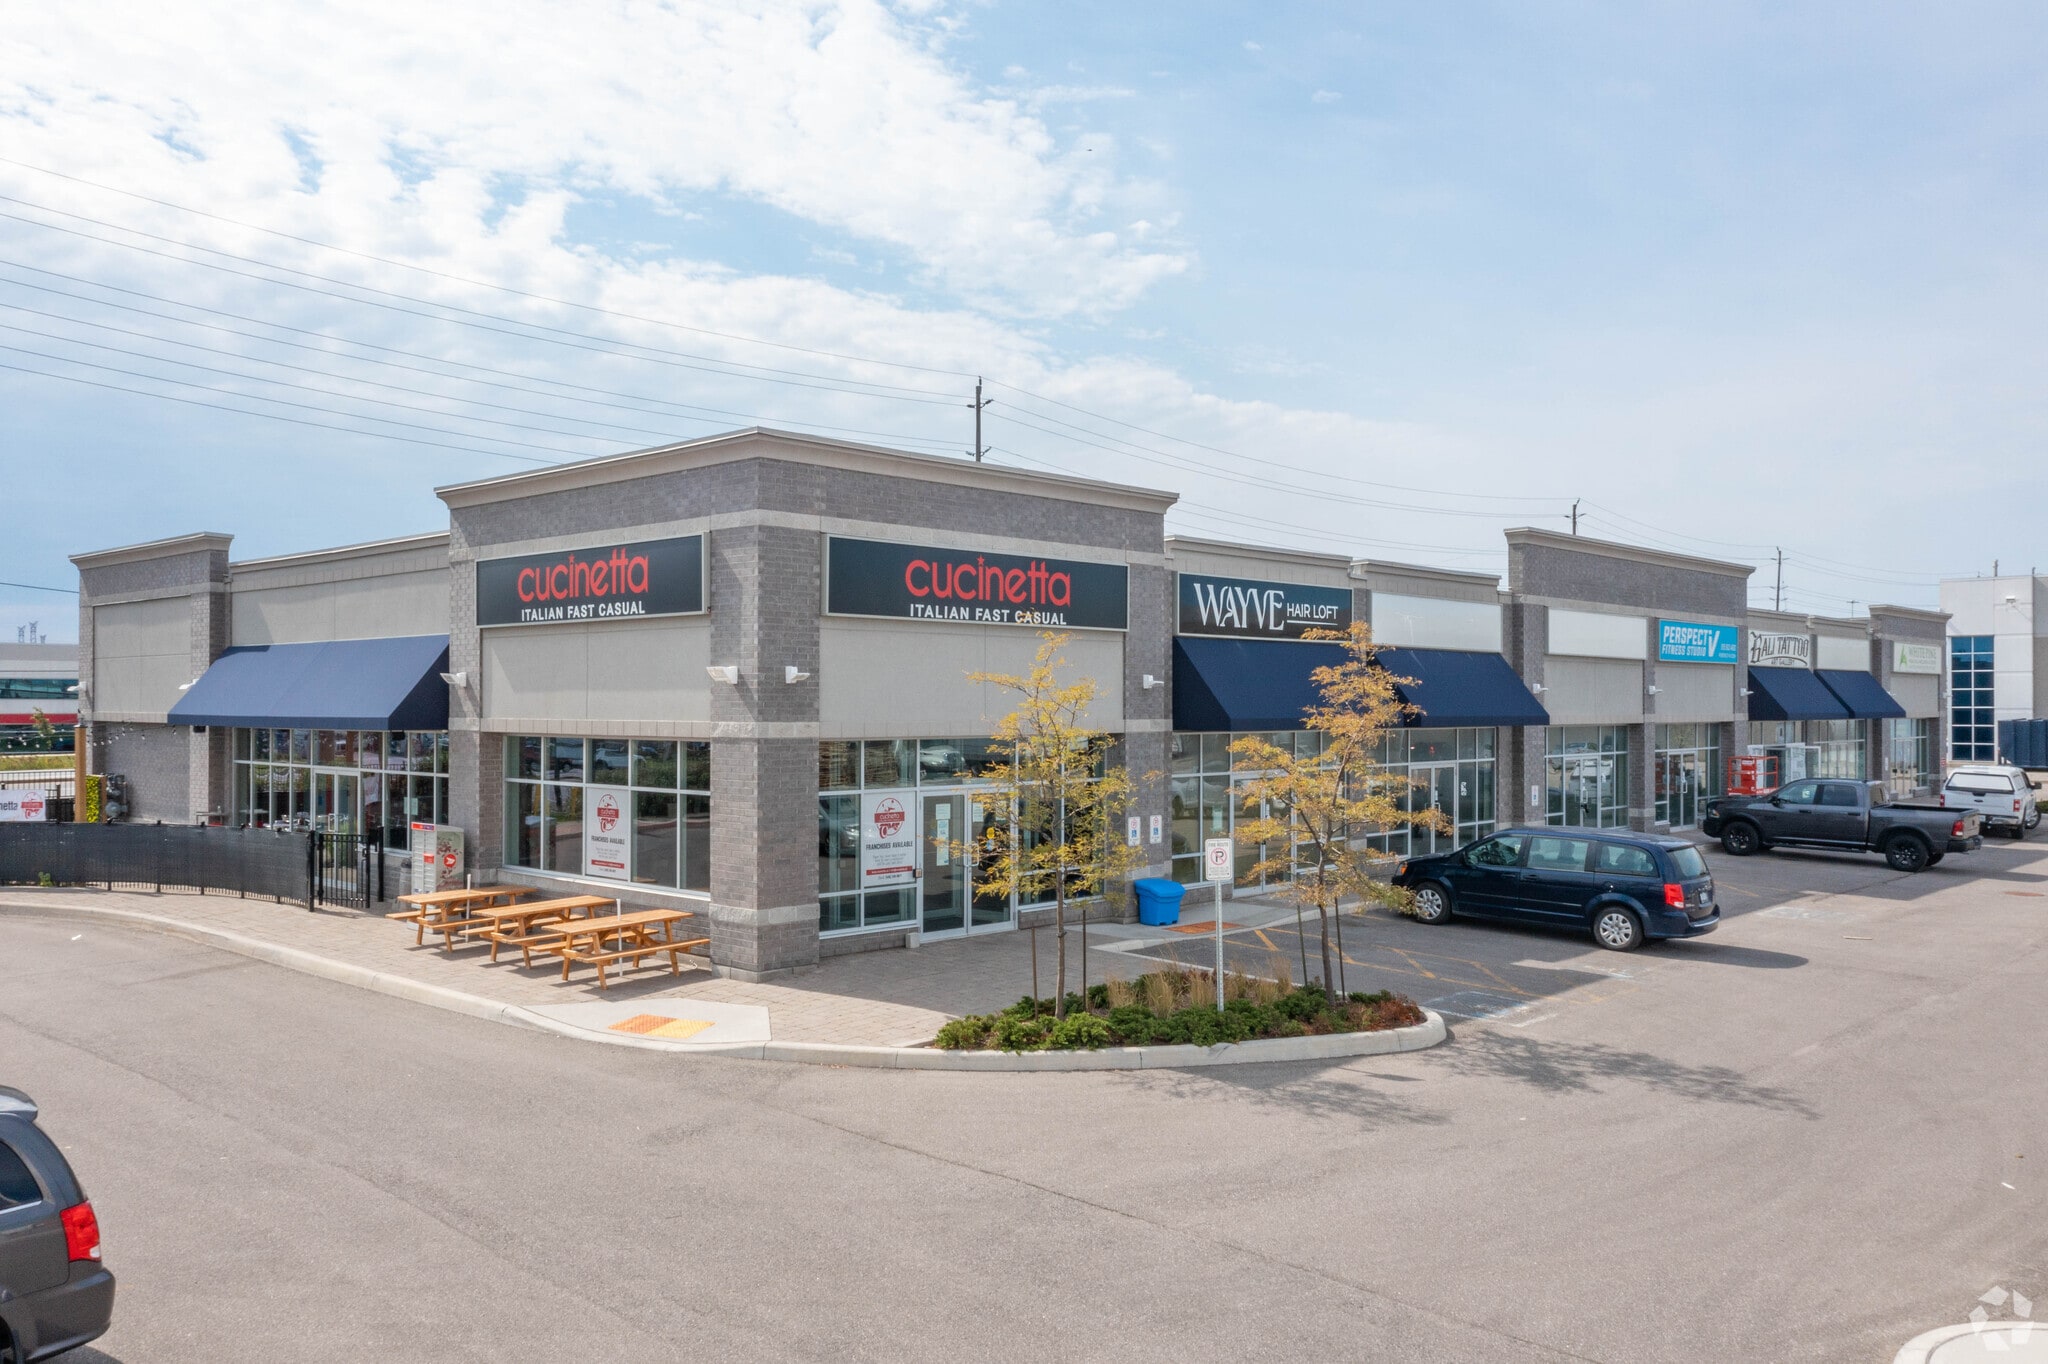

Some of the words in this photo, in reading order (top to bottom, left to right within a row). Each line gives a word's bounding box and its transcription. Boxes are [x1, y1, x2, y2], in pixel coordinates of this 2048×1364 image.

[518, 547, 648, 602] cucinetta
[905, 555, 1071, 607] cucinetta
[521, 607, 563, 622] ITALIAN
[567, 604, 595, 619] FAST
[599, 601, 645, 617] CASUAL
[910, 603, 969, 620] ITALIAN
[975, 607, 1010, 622] FAST
[1015, 609, 1067, 625] CASUAL
[1193, 583, 1285, 631] WAYVE
[1287, 603, 1310, 618] HAIR
[1313, 605, 1339, 620] LOFT
[1661, 643, 1686, 656] FITNESS
[1686, 645, 1706, 657] STUDIO
[1777, 636, 1809, 657] TATTOO
[866, 842, 891, 851] FRANCHISES
[892, 840, 913, 849] AVAILABLE
